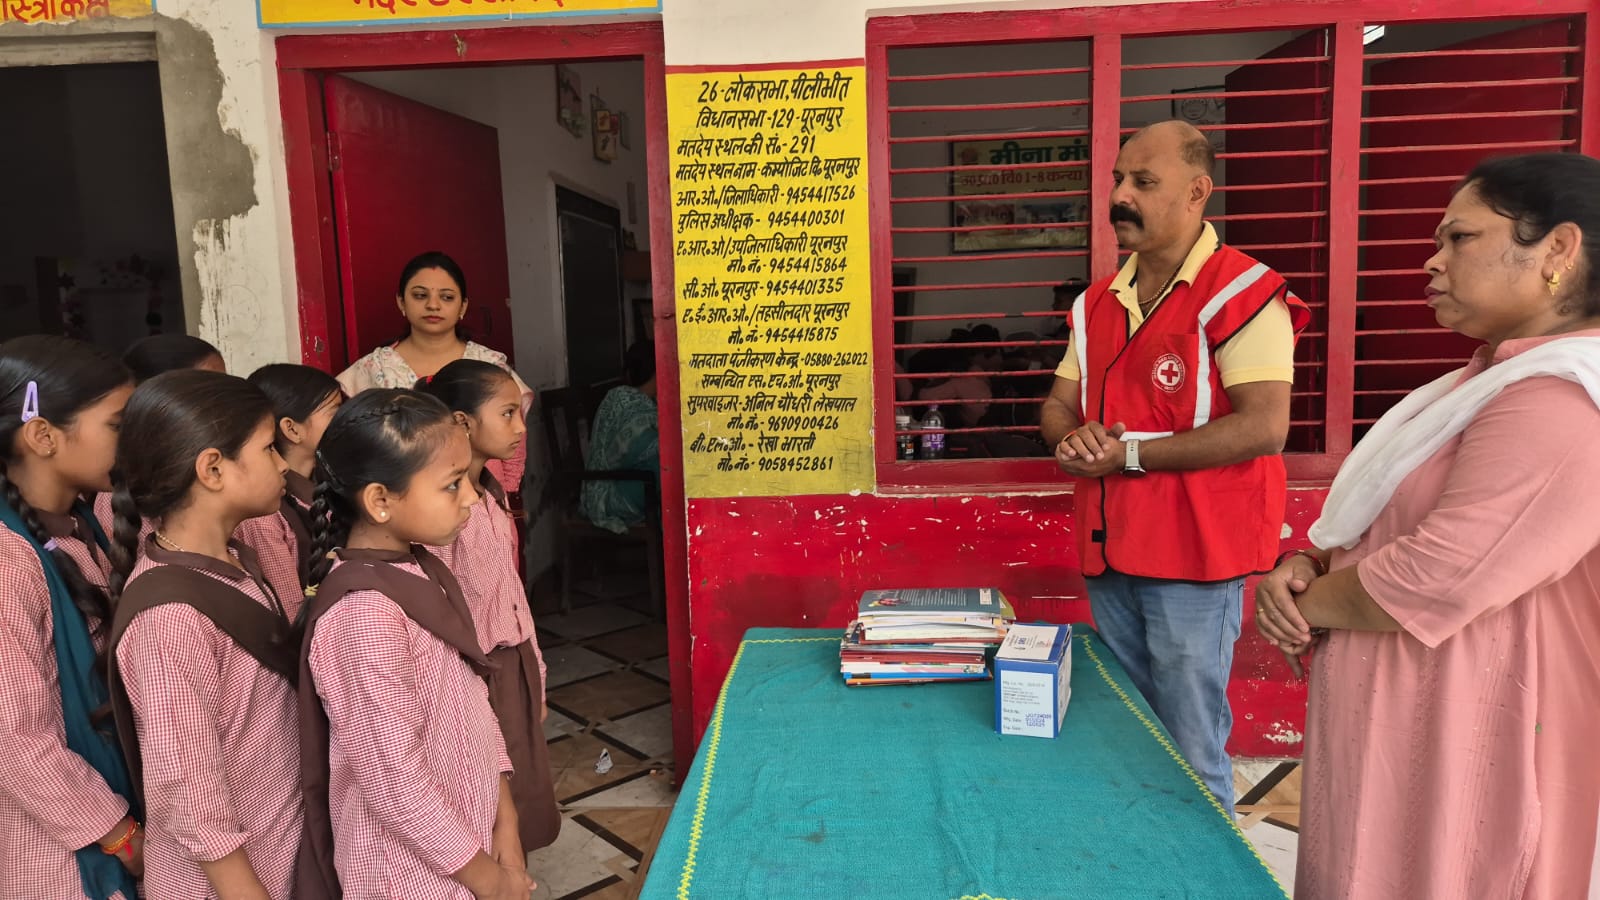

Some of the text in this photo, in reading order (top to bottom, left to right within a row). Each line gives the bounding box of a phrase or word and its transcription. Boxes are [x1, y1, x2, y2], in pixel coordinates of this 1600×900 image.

[677, 133, 714, 157] मतदेय
[789, 135, 816, 154] 291
[989, 139, 1089, 166] मीना मं
[676, 159, 706, 182] मतदेय
[823, 157, 861, 180] पूरनपुर
[786, 185, 856, 205] 9454417526
[677, 210, 710, 233] पुलिस
[767, 209, 845, 228] 9454400301
[809, 235, 848, 256] पूरनपुर
[769, 257, 848, 273] 9454415864
[766, 277, 845, 296] 9454401335
[814, 302, 851, 323] पूरनपुर
[765, 327, 839, 343] 9454415875
[689, 353, 729, 369] मतदाता
[729, 348, 776, 369] पंजीकरण
[701, 369, 747, 390] सम्बन्धित
[805, 373, 842, 393] पूरनपुर
[777, 391, 813, 412] चौधरी
[813, 393, 857, 412] लेखपाल
[767, 416, 839, 431] 9690900426
[757, 431, 779, 452] रेखा
[781, 432, 816, 452] भारती
[758, 456, 833, 471] 9058452861
